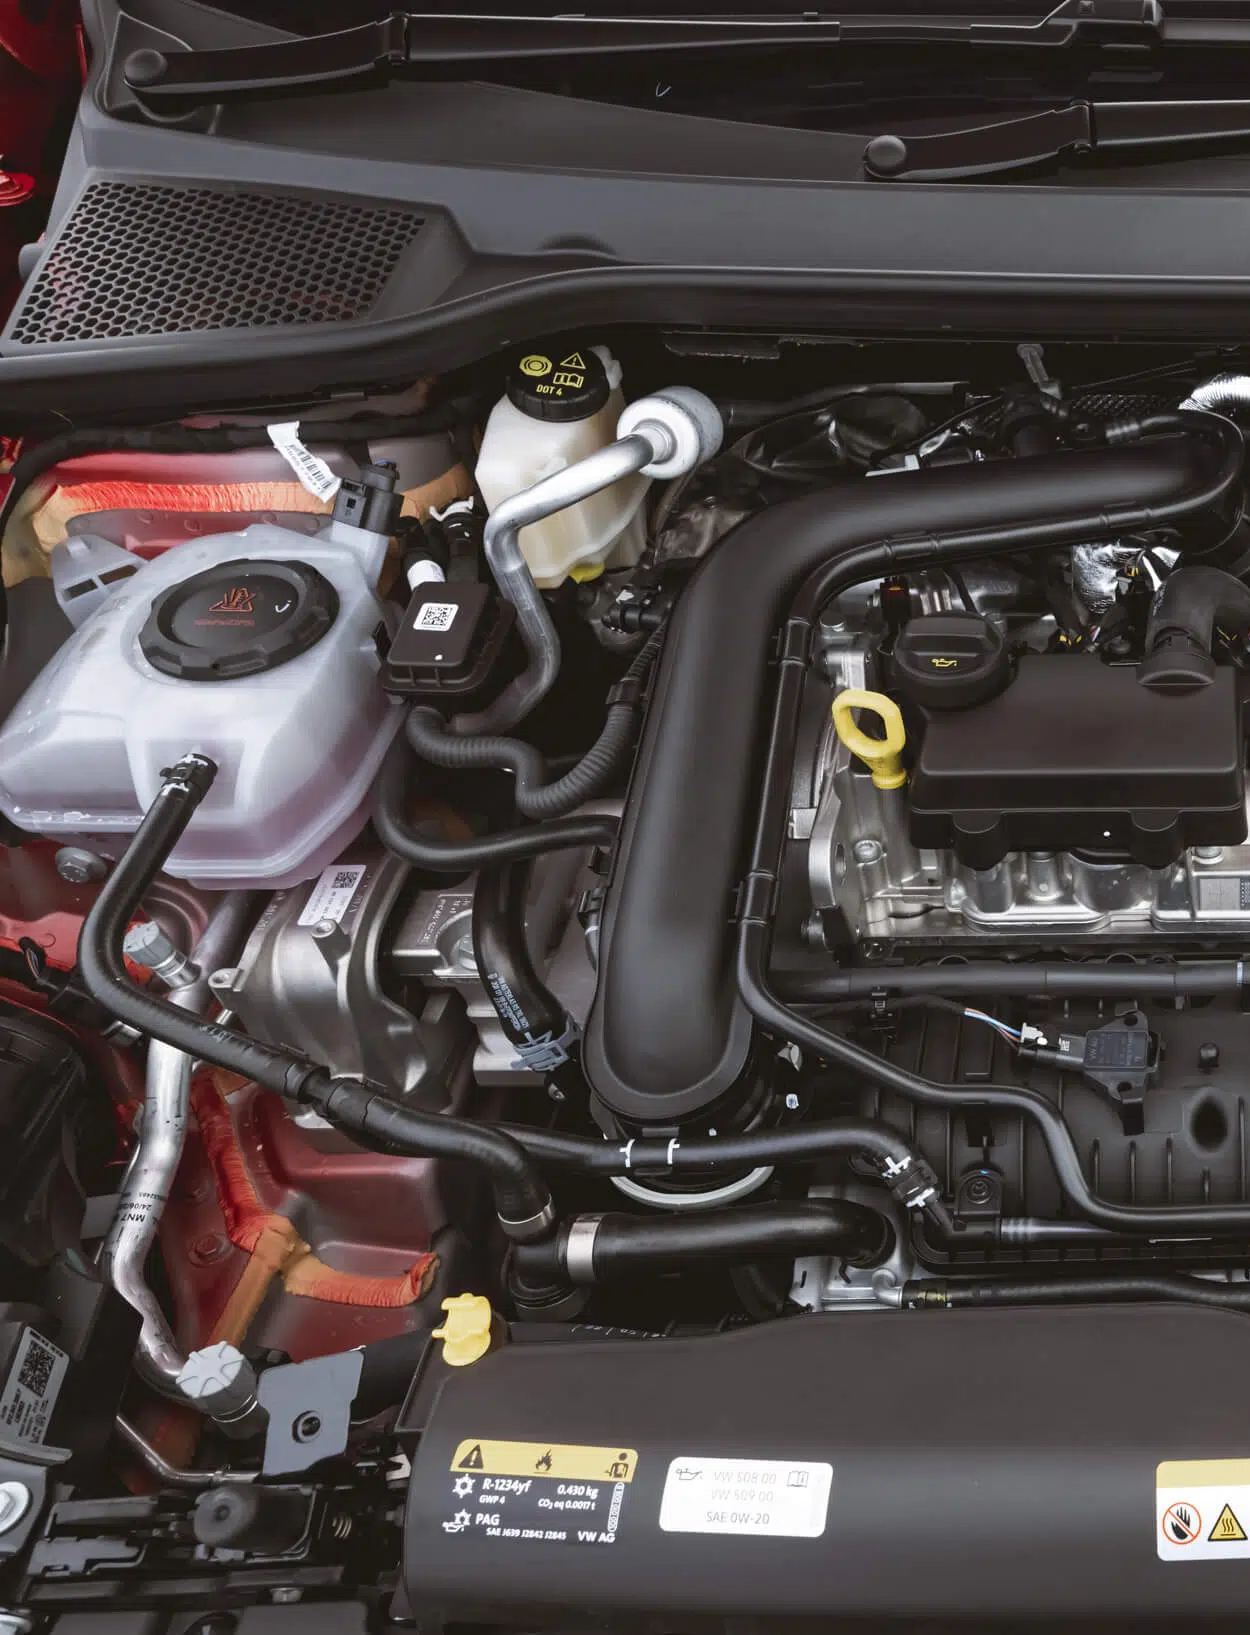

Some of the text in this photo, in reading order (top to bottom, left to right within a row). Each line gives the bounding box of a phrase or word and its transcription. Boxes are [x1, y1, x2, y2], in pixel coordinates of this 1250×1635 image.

[536, 384, 562, 396] DOT 4
[714, 1471, 733, 1482] VW
[482, 1478, 599, 1499] R-1234yf 0.430 kg
[711, 1489, 731, 1500] VW
[479, 1495, 499, 1504] GWP
[499, 1495, 506, 1505] 4
[553, 1501, 563, 1511] eq
[564, 1500, 590, 1510] 0.0017
[475, 1513, 500, 1525] PAG
[706, 1511, 770, 1525] SAE 0W-20
[486, 1527, 501, 1536] SAE
[577, 1531, 596, 1541] VW
[597, 1532, 616, 1543] AG
